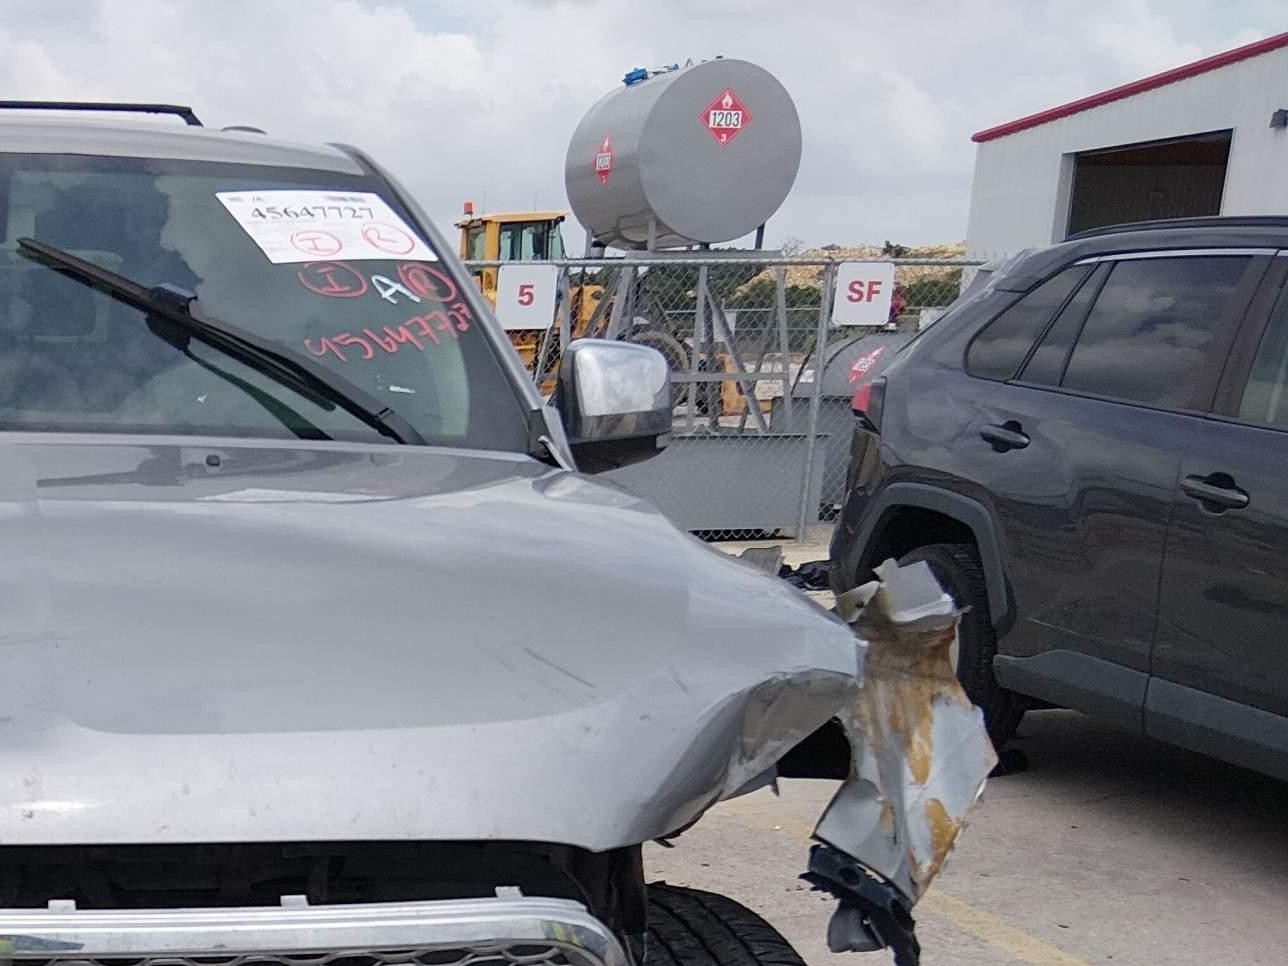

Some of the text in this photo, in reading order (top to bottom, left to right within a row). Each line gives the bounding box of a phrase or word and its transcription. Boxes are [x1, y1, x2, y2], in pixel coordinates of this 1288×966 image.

[712, 111, 740, 127] 1203
[720, 133, 727, 142] 3
[251, 206, 374, 219] 45647727
[371, 274, 421, 304] A
[518, 284, 534, 306] 5
[846, 280, 883, 303] SF
